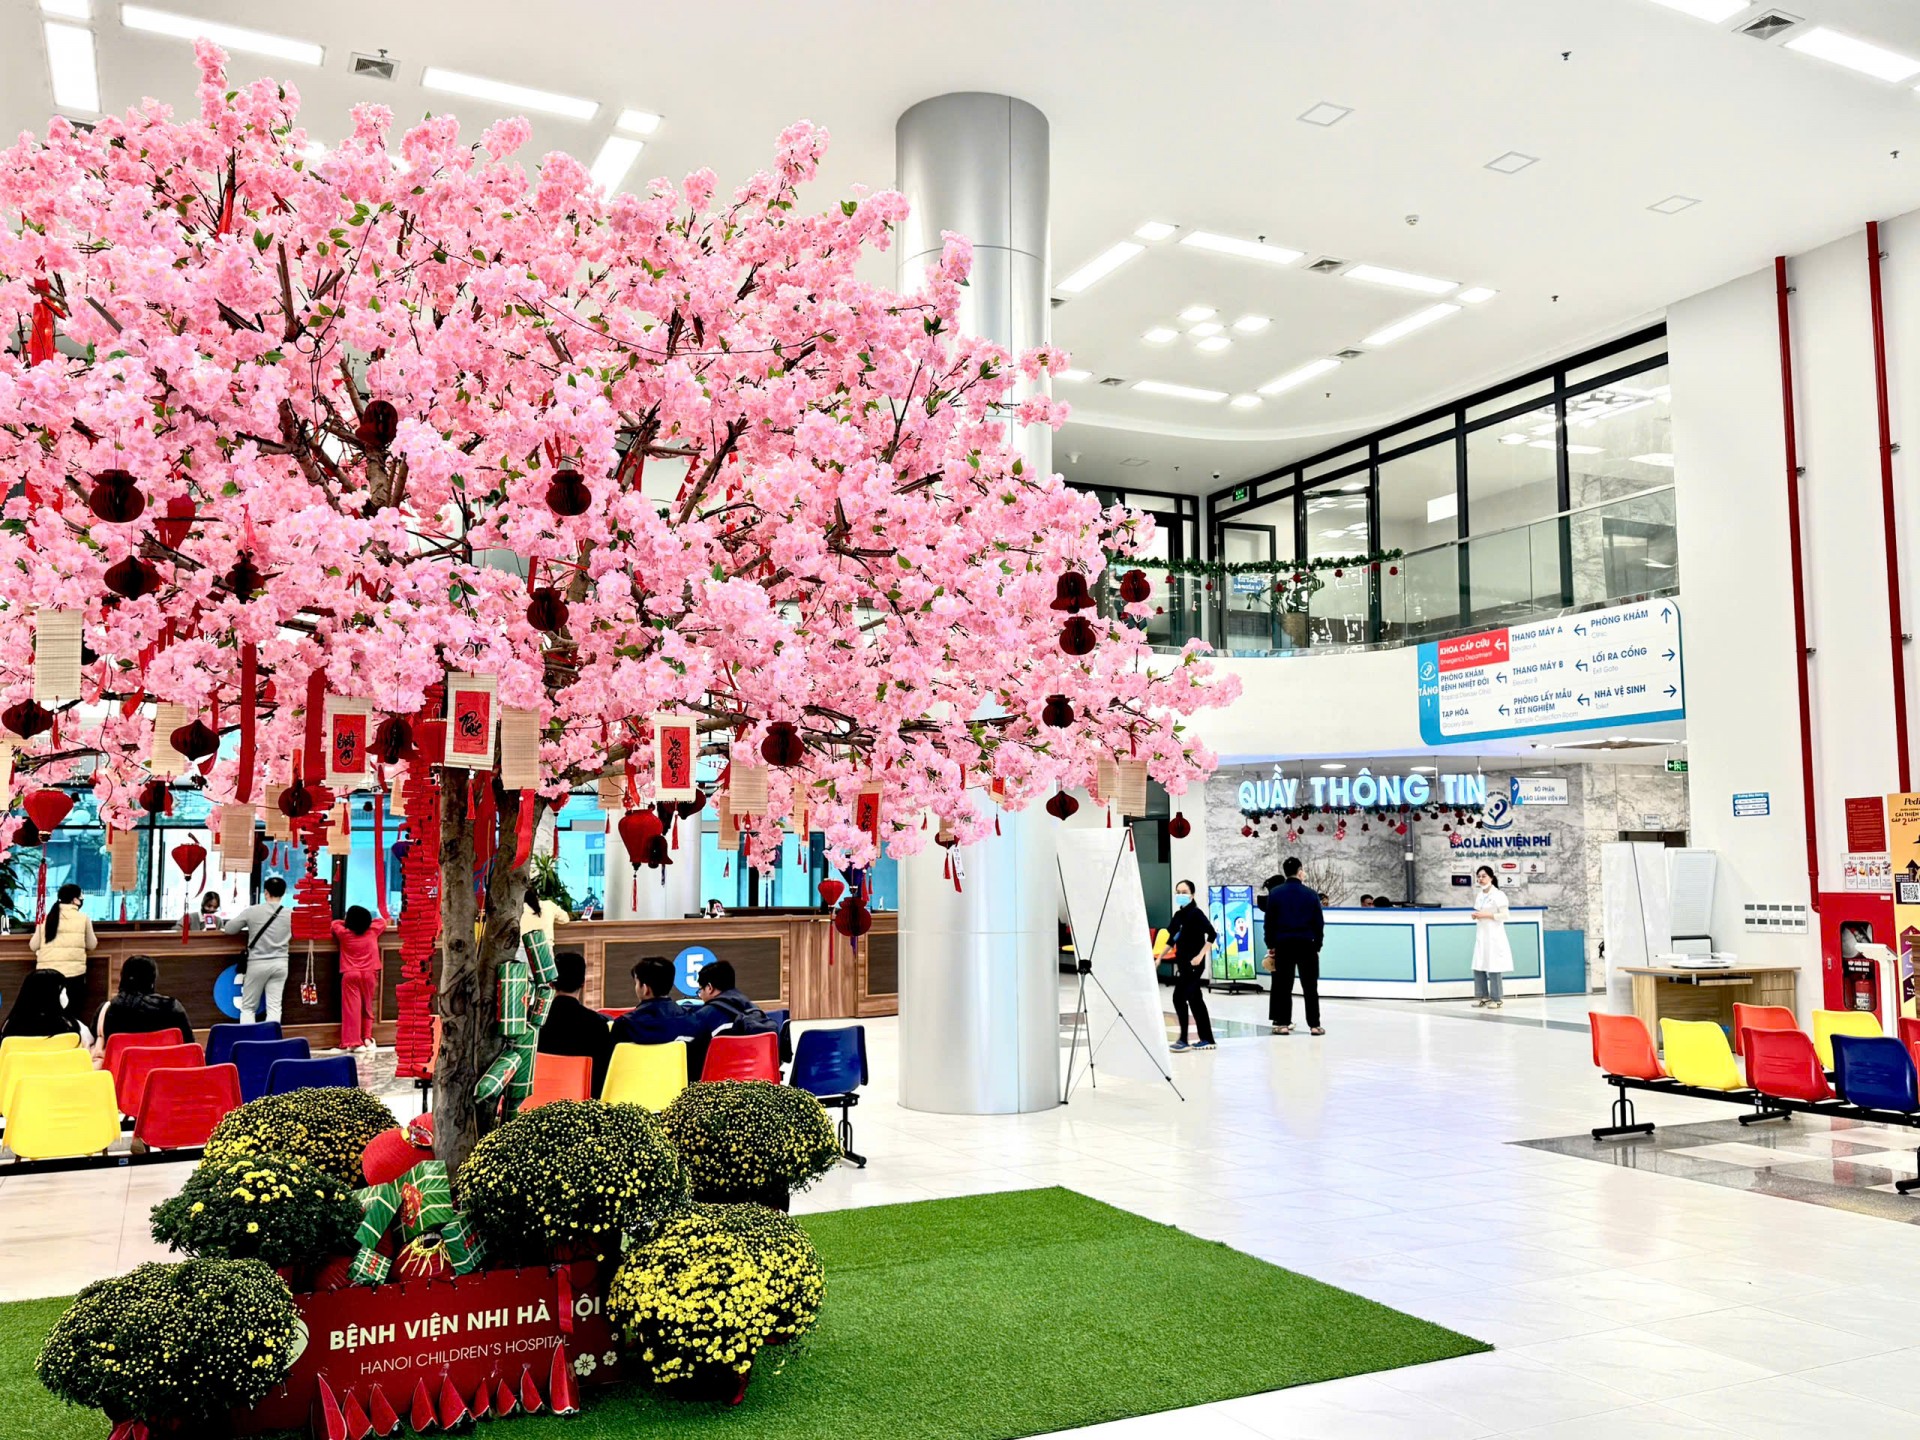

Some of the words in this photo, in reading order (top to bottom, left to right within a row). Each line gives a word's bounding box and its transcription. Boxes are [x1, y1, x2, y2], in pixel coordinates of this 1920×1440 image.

[1591, 615, 1620, 628] PHÒNG
[1623, 609, 1648, 621] KHÁM
[1512, 630, 1536, 642] THANG
[1538, 626, 1555, 637] MÁY
[1440, 646, 1458, 655] KHOA
[1460, 640, 1474, 652] CẤP
[1592, 651, 1606, 663] LỐI
[1608, 652, 1618, 660] RA
[1620, 645, 1648, 658] CỔNG
[1441, 672, 1464, 682] PHÒNG
[1465, 668, 1484, 678] KHÁM
[1513, 664, 1538, 676] THANG
[1540, 660, 1557, 671] MÁY
[1419, 684, 1438, 696] TẦNG
[1441, 682, 1456, 692] BỆNH
[1458, 680, 1475, 689] NHIỆT
[1594, 687, 1612, 698] NHÀ
[1614, 685, 1624, 697] VỆ
[1626, 684, 1646, 694] SINH
[1427, 698, 1431, 708] 1
[1514, 694, 1538, 705] PHÒNG
[1540, 690, 1554, 702] LẤY
[1556, 688, 1572, 700] MẪU
[1442, 711, 1453, 719] TẠP
[1515, 705, 1526, 714] XÉT
[1528, 702, 1555, 714] NGHIỆM
[1238, 764, 1298, 810] QUẦY
[1310, 768, 1430, 806] THÔNG
[1441, 774, 1486, 804] TIN
[1473, 834, 1502, 848] LÃNH
[1504, 833, 1531, 850] VIỆN
[1532, 832, 1552, 847] PHÍ
[686, 954, 704, 988] 5
[330, 1323, 396, 1354] BỆNH
[404, 1312, 460, 1342] VIỆN
[466, 1308, 508, 1331] NHI
[517, 1298, 551, 1324] HÀ
[570, 1293, 600, 1322] ỘI
[360, 1356, 412, 1375] HANOI
[416, 1343, 502, 1368] CHILDREN'S
[505, 1334, 570, 1354] HOSPITAL
